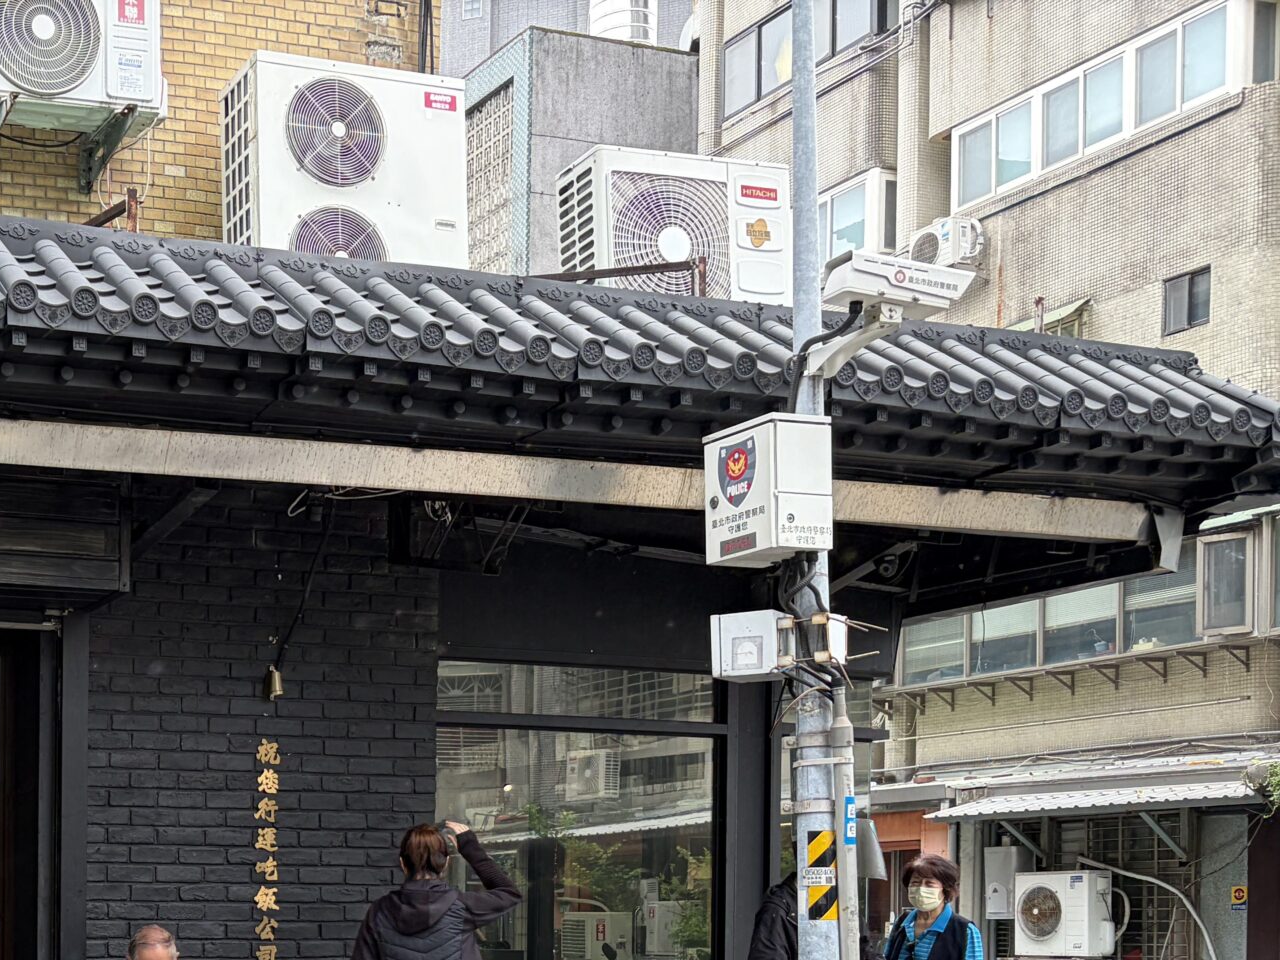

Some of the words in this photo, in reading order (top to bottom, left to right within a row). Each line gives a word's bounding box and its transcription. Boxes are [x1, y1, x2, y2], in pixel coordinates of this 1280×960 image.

[742, 188, 776, 199] HITACHI
[726, 481, 749, 498] POLICE
[711, 504, 766, 529] 臺北市政府警察局
